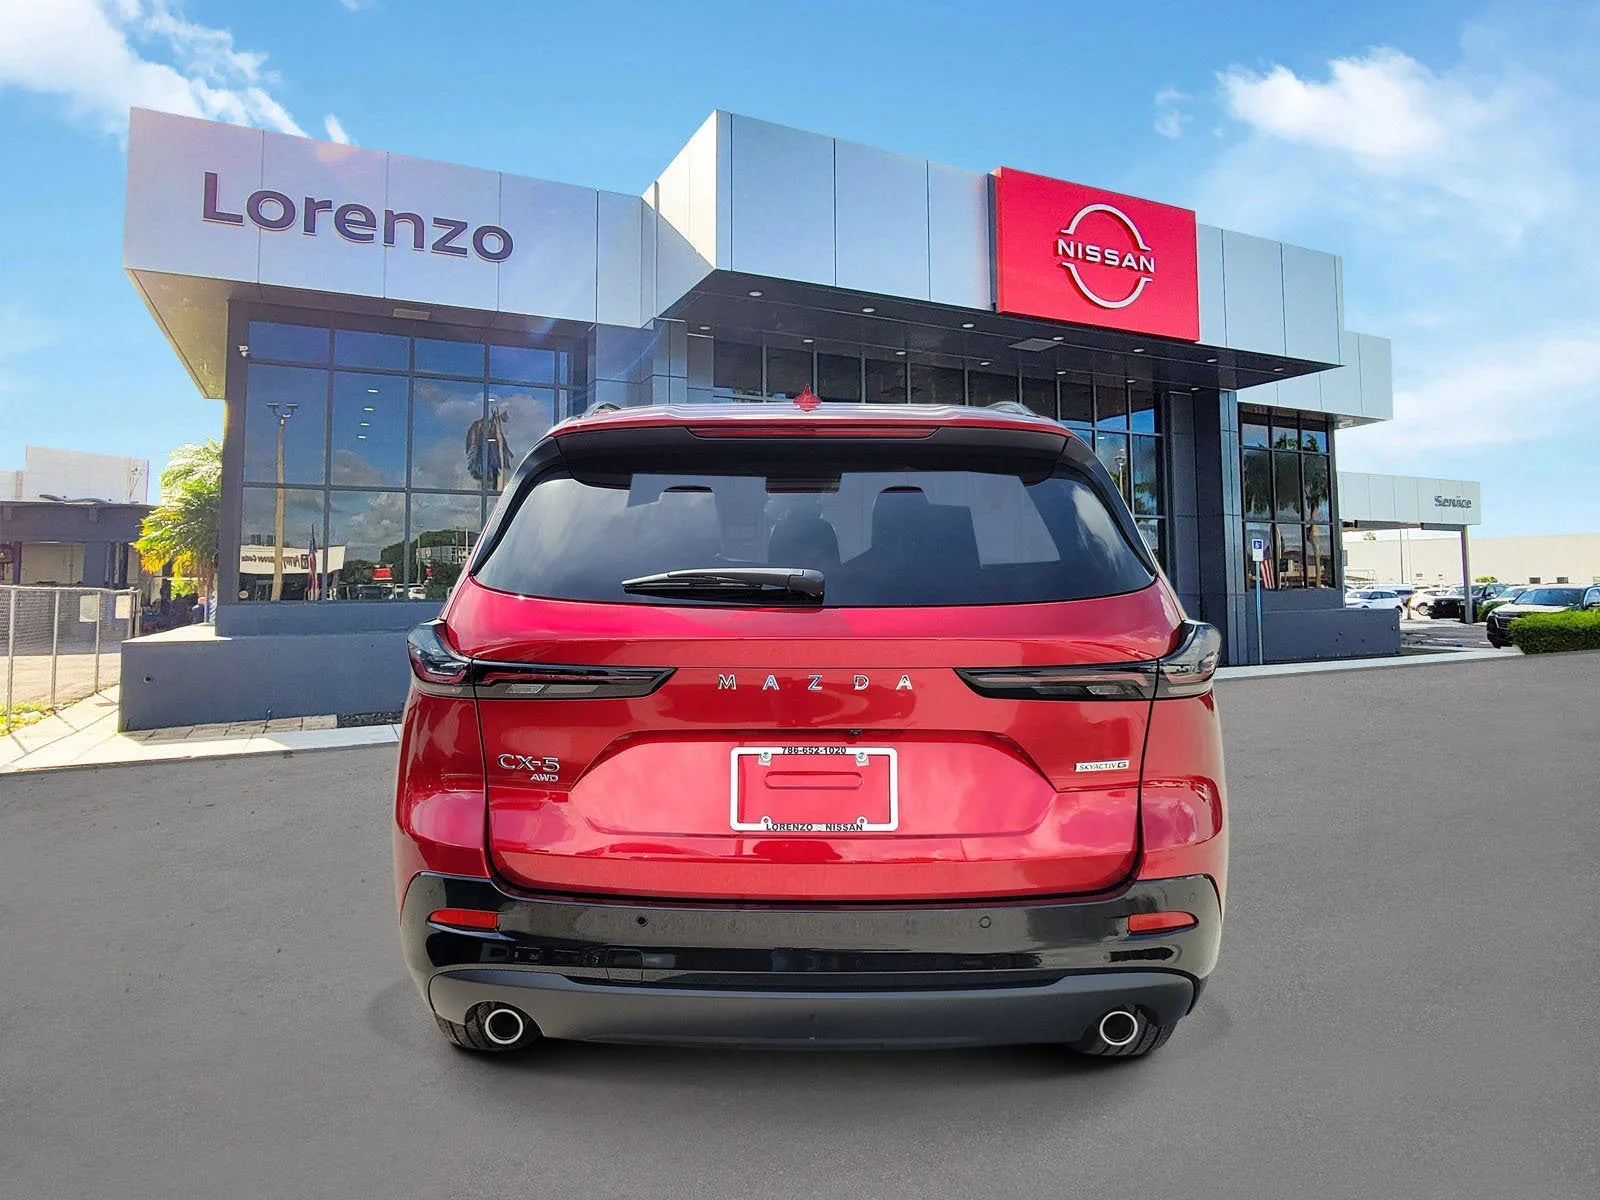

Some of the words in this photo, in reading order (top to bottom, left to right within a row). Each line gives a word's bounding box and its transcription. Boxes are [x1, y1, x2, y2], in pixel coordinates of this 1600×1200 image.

[202, 171, 514, 262] Lorenzo
[1057, 238, 1155, 273] NISSAN
[1434, 495, 1472, 509] Service
[717, 673, 913, 691] MAZDA
[781, 746, 847, 755] 786-652-1020
[497, 753, 560, 773] CX-5
[530, 773, 559, 782] AWD
[766, 823, 813, 832] LORENZO
[825, 823, 863, 832] NISSAN
